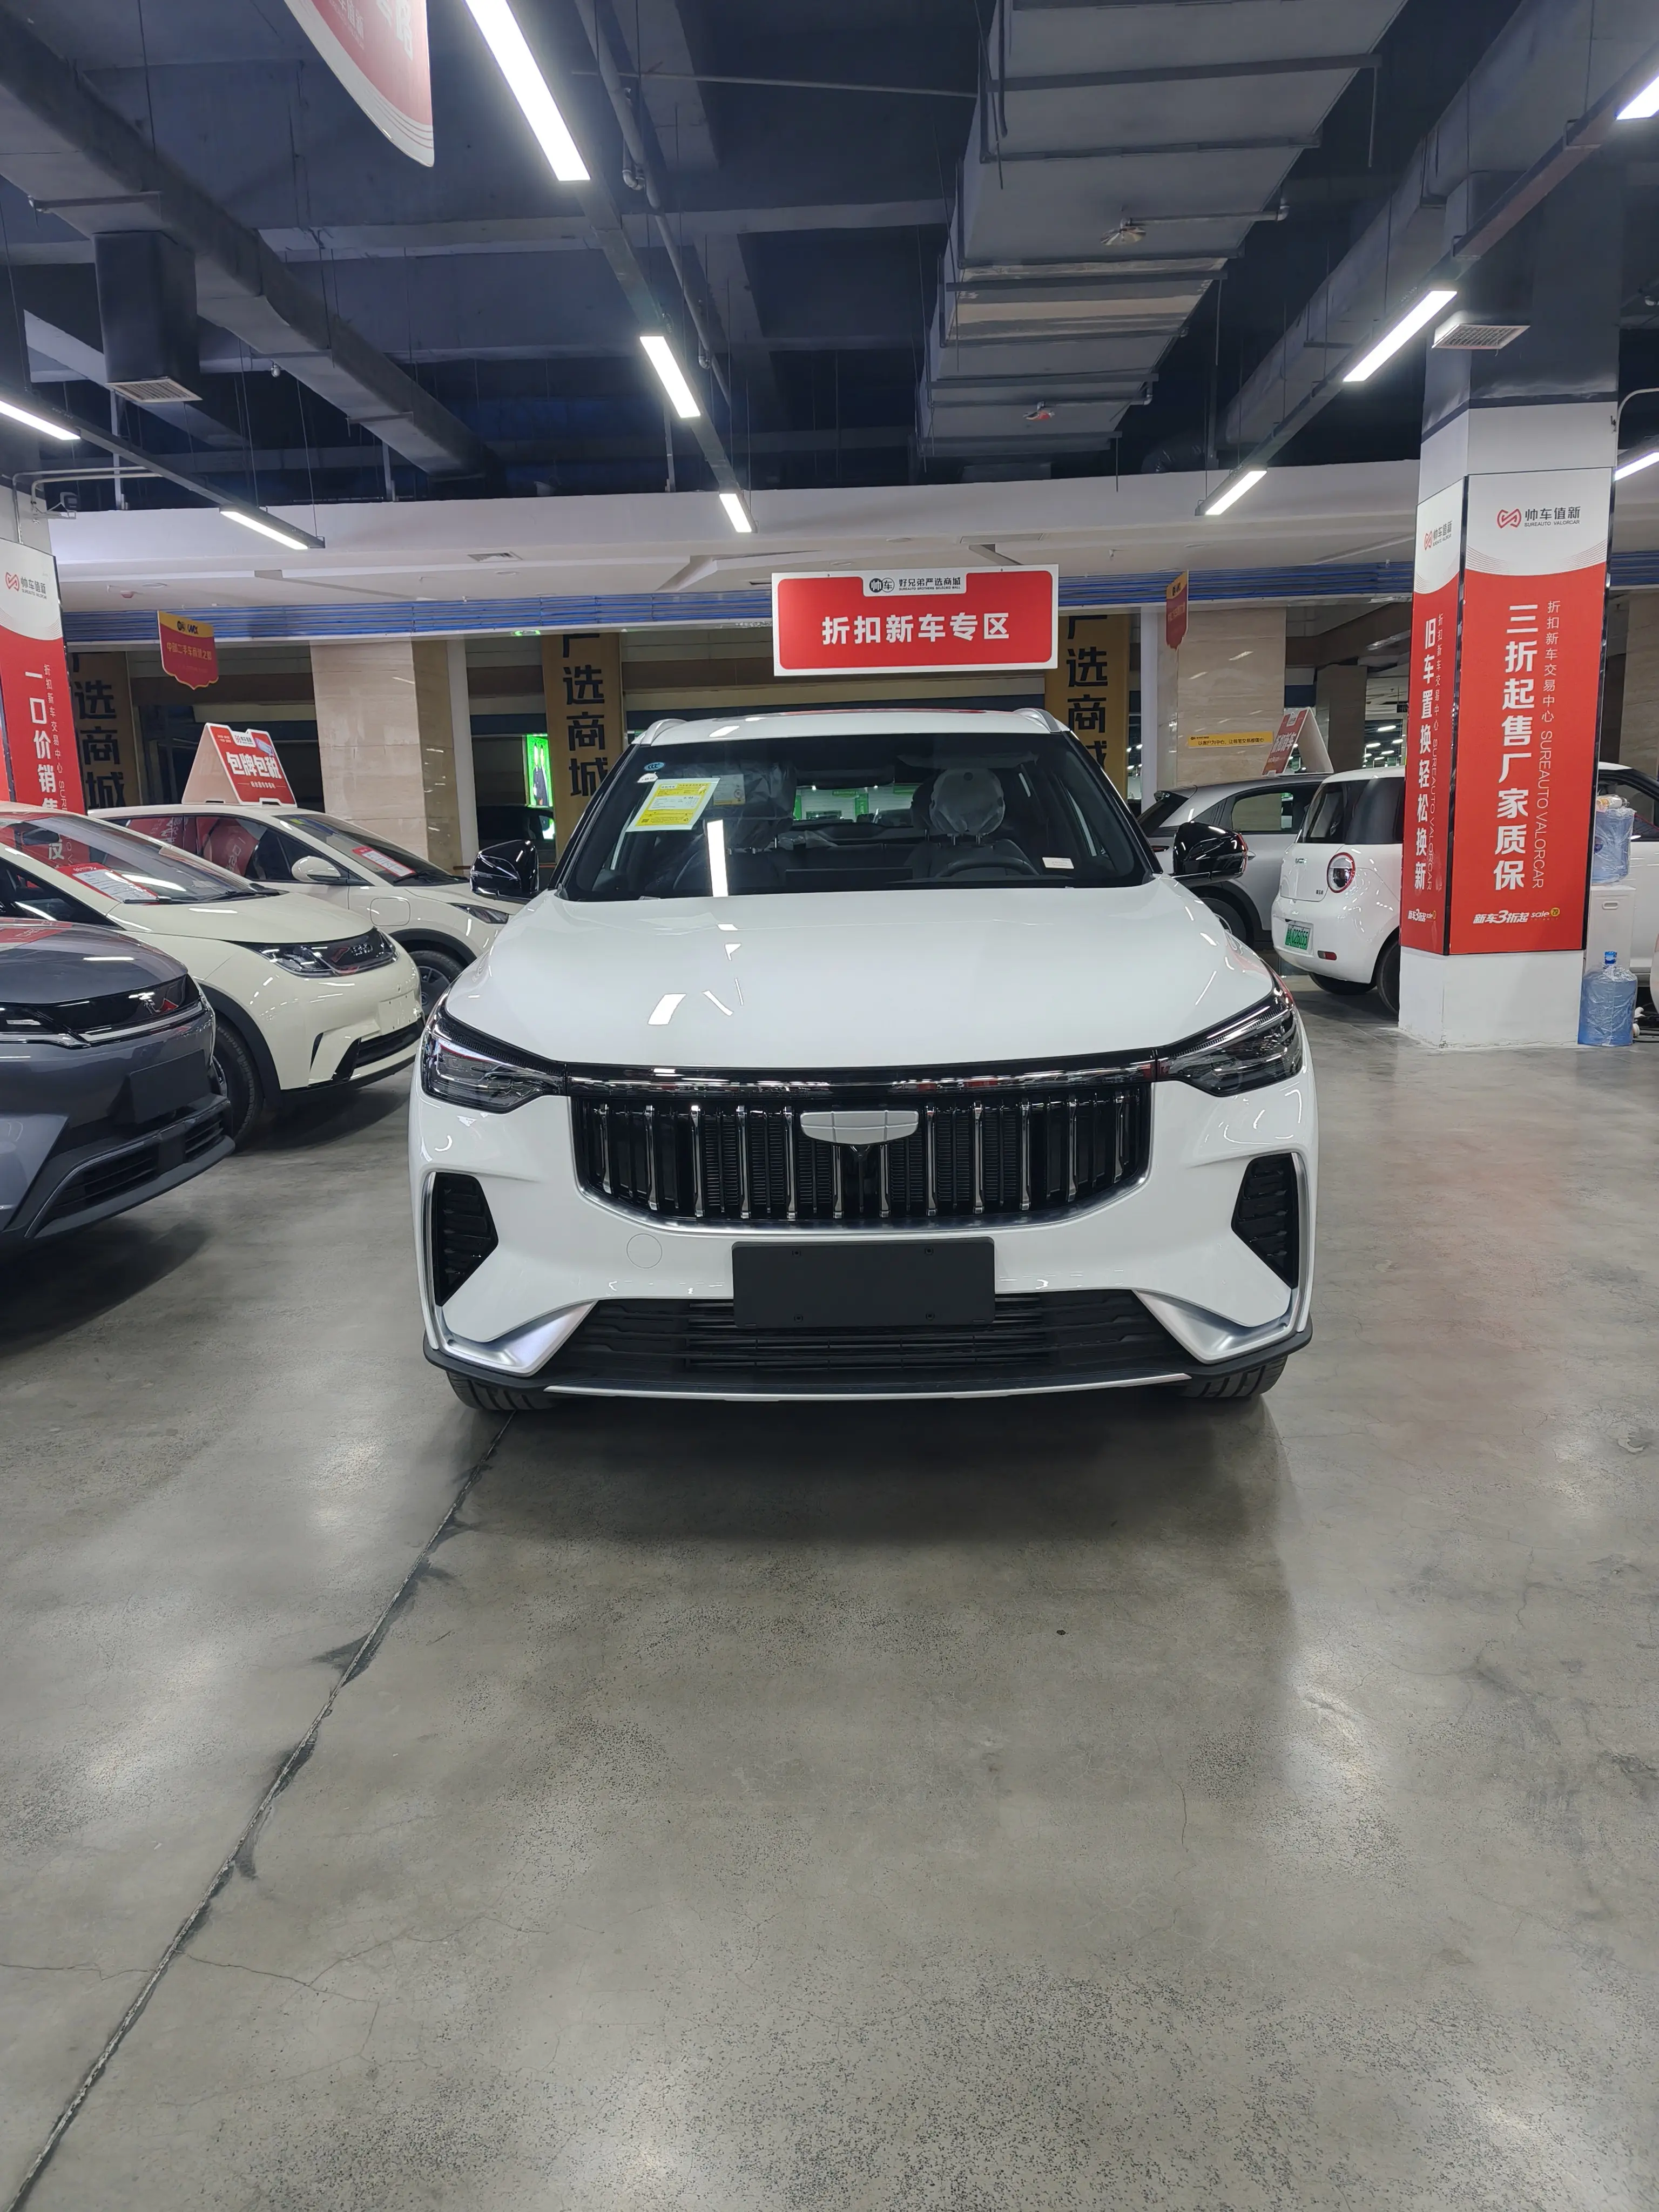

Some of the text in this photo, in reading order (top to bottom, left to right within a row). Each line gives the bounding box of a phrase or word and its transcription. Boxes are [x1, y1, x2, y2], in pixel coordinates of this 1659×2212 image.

[1525, 507, 1581, 521] 帅车值新
[869, 577, 961, 592] 帅车 好兄弟严选商城
[822, 612, 1009, 645] 折扣新车专区
[1433, 613, 1444, 731] 折扣新车交易中心
[44, 664, 63, 773] 折扣新车交易中心
[1415, 618, 1436, 890] 旧车置换轻松换新
[1494, 605, 1538, 890] 三折起售厂家质保
[1532, 601, 1560, 888] 折扣新车交易中心 SUREAUTO VALORCAR
[226, 752, 282, 779] 包牌包税
[1408, 908, 1426, 922] 新车3折起
[1473, 910, 1529, 924] 新车3折起
